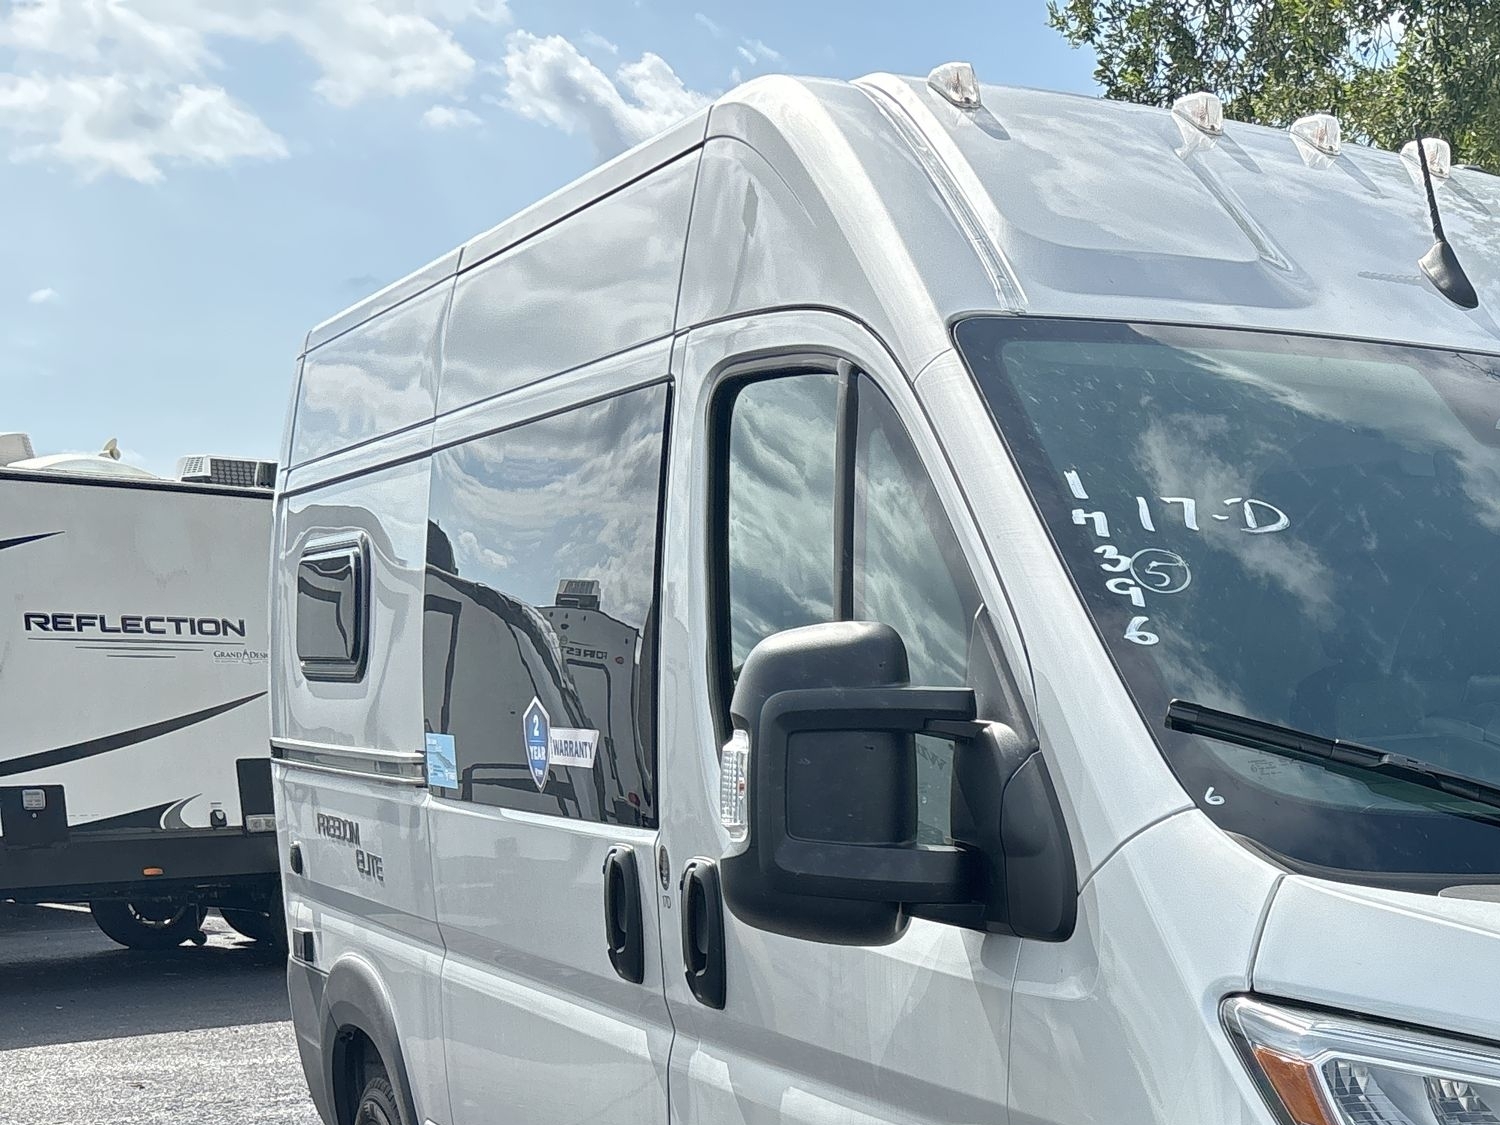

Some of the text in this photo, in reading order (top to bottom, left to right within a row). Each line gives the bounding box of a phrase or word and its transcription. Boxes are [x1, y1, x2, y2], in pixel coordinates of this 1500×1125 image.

[23, 611, 246, 638] REFLECTION
[532, 714, 540, 737] 2
[528, 745, 547, 761] YEAR
[552, 738, 594, 760] WARRANTY
[1204, 786, 1226, 806] 6
